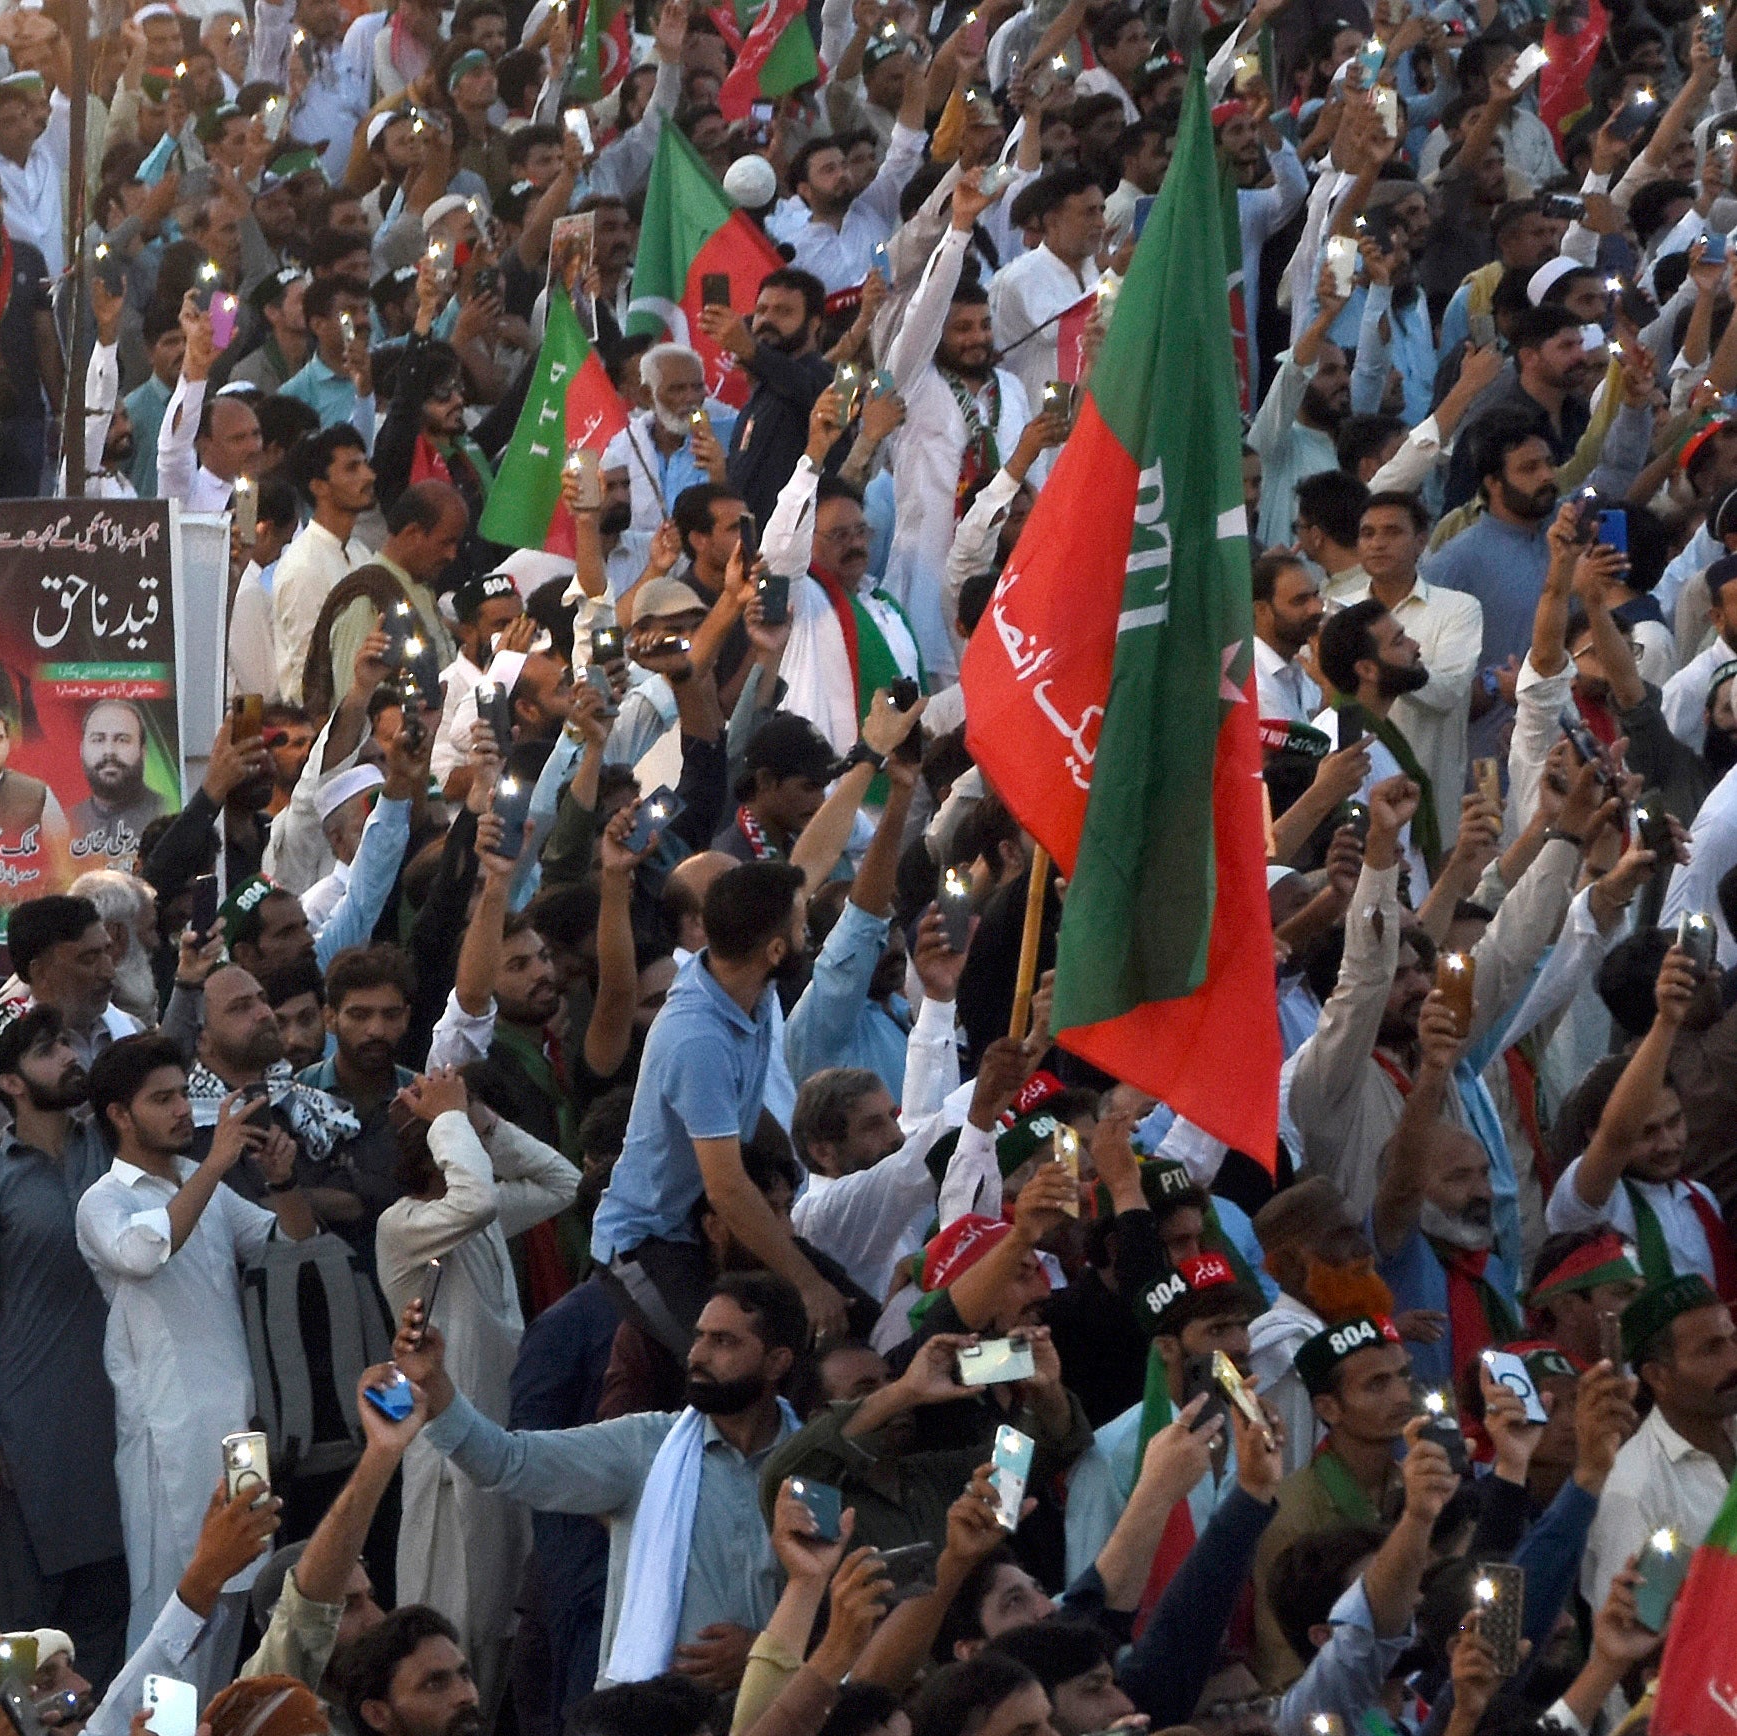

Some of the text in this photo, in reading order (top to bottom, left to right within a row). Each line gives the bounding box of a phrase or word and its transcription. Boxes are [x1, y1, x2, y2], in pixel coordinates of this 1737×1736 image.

[1115, 459, 1174, 634] PTI
[109, 576, 160, 649] قید
[0, 824, 40, 857] ملک
[236, 881, 270, 911] 804
[1160, 1168, 1191, 1194] PTI
[1146, 1273, 1187, 1314] 804
[1329, 1320, 1376, 1355] 804
